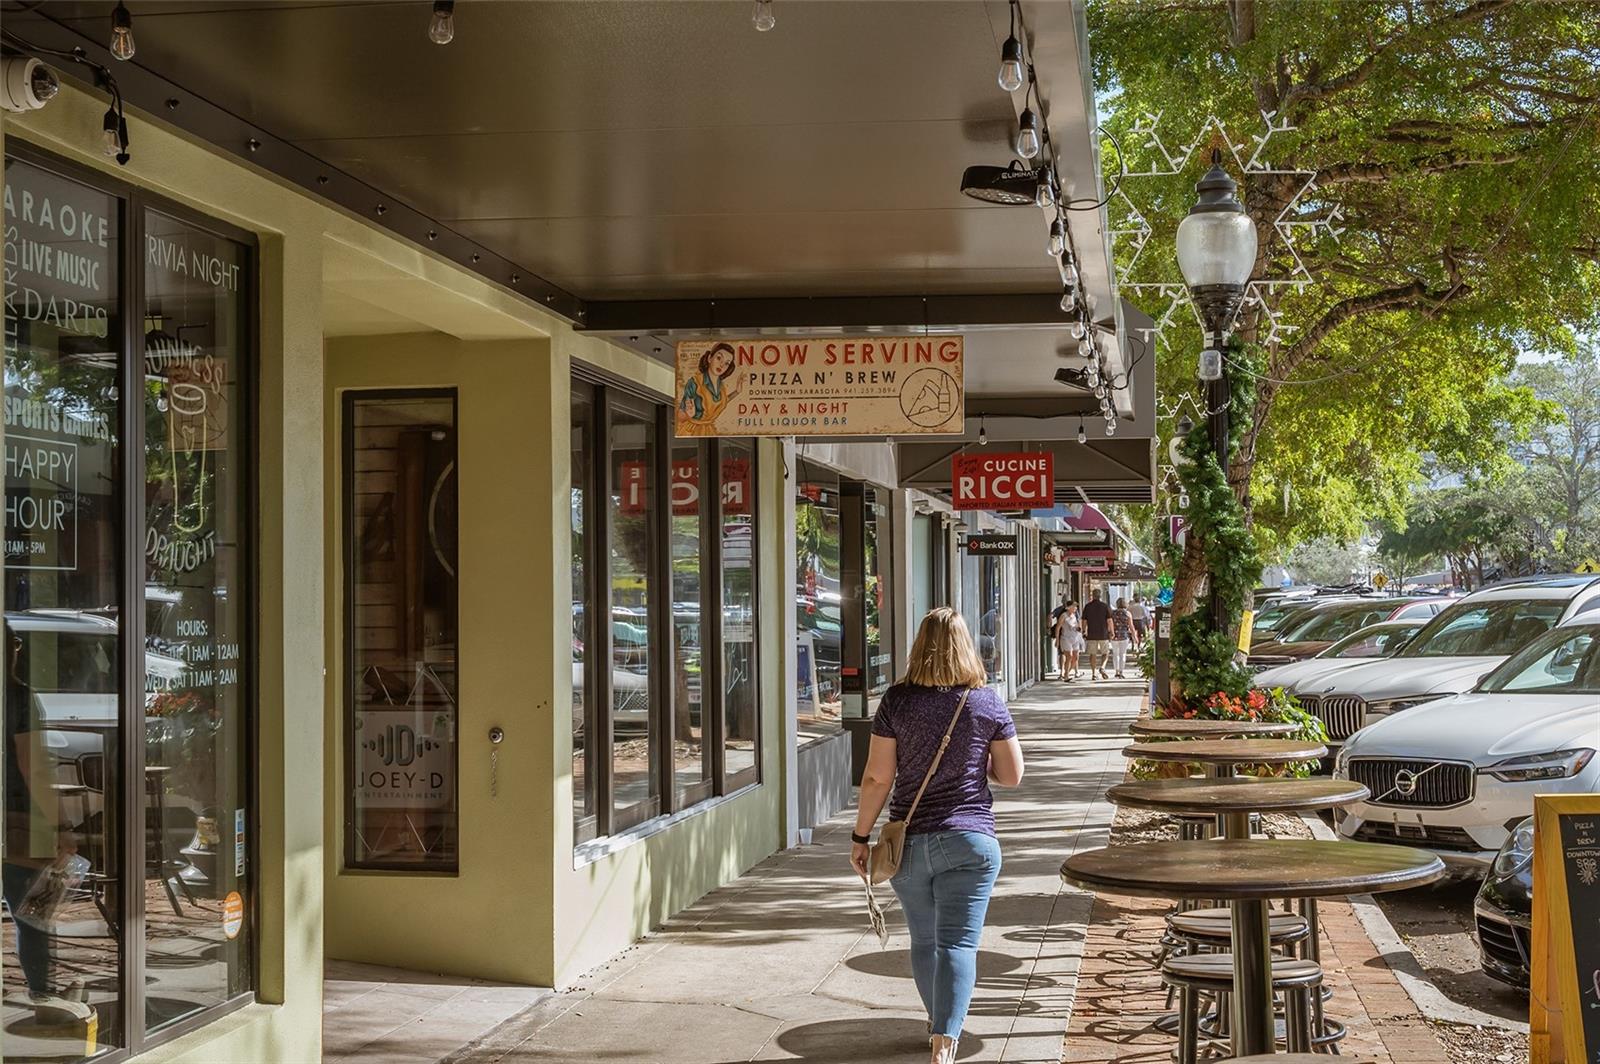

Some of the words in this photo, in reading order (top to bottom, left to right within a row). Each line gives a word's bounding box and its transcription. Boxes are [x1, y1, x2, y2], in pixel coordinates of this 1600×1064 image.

[4, 184, 108, 248] ARAOKE
[22, 239, 52, 277] LIVE
[56, 250, 100, 291] MUSIC
[145, 233, 188, 275] RIVIA
[192, 250, 240, 292] NIGHT
[22, 286, 108, 339] DARTS
[737, 344, 808, 366] NOW
[824, 341, 960, 366] SERVING
[750, 372, 802, 385] PIZZA
[815, 371, 834, 385] N'
[845, 370, 897, 384] BREW
[4, 395, 60, 432] SPORTS
[62, 406, 109, 441] GAMES
[739, 403, 771, 415] DAY
[780, 402, 788, 414] &
[798, 402, 849, 414] NIGHT
[738, 417, 764, 426] FULL
[771, 416, 817, 426] LIQUOR
[823, 416, 848, 426] BAR
[4, 444, 74, 483] HAPPY
[983, 459, 1047, 472] CUCINE
[959, 474, 1047, 499] RICCI
[4, 495, 65, 531] HOUR
[31, 541, 46, 554] 5PM
[145, 526, 215, 572] DRAUGHT
[176, 620, 208, 636] HOURS:
[187, 645, 210, 661] 11AM
[217, 644, 239, 660] 12AM
[190, 670, 213, 687] 11AM
[220, 669, 237, 684] 2AM
[358, 771, 443, 789] JOEY-D
[1567, 850, 1600, 859] DOWNTOW
